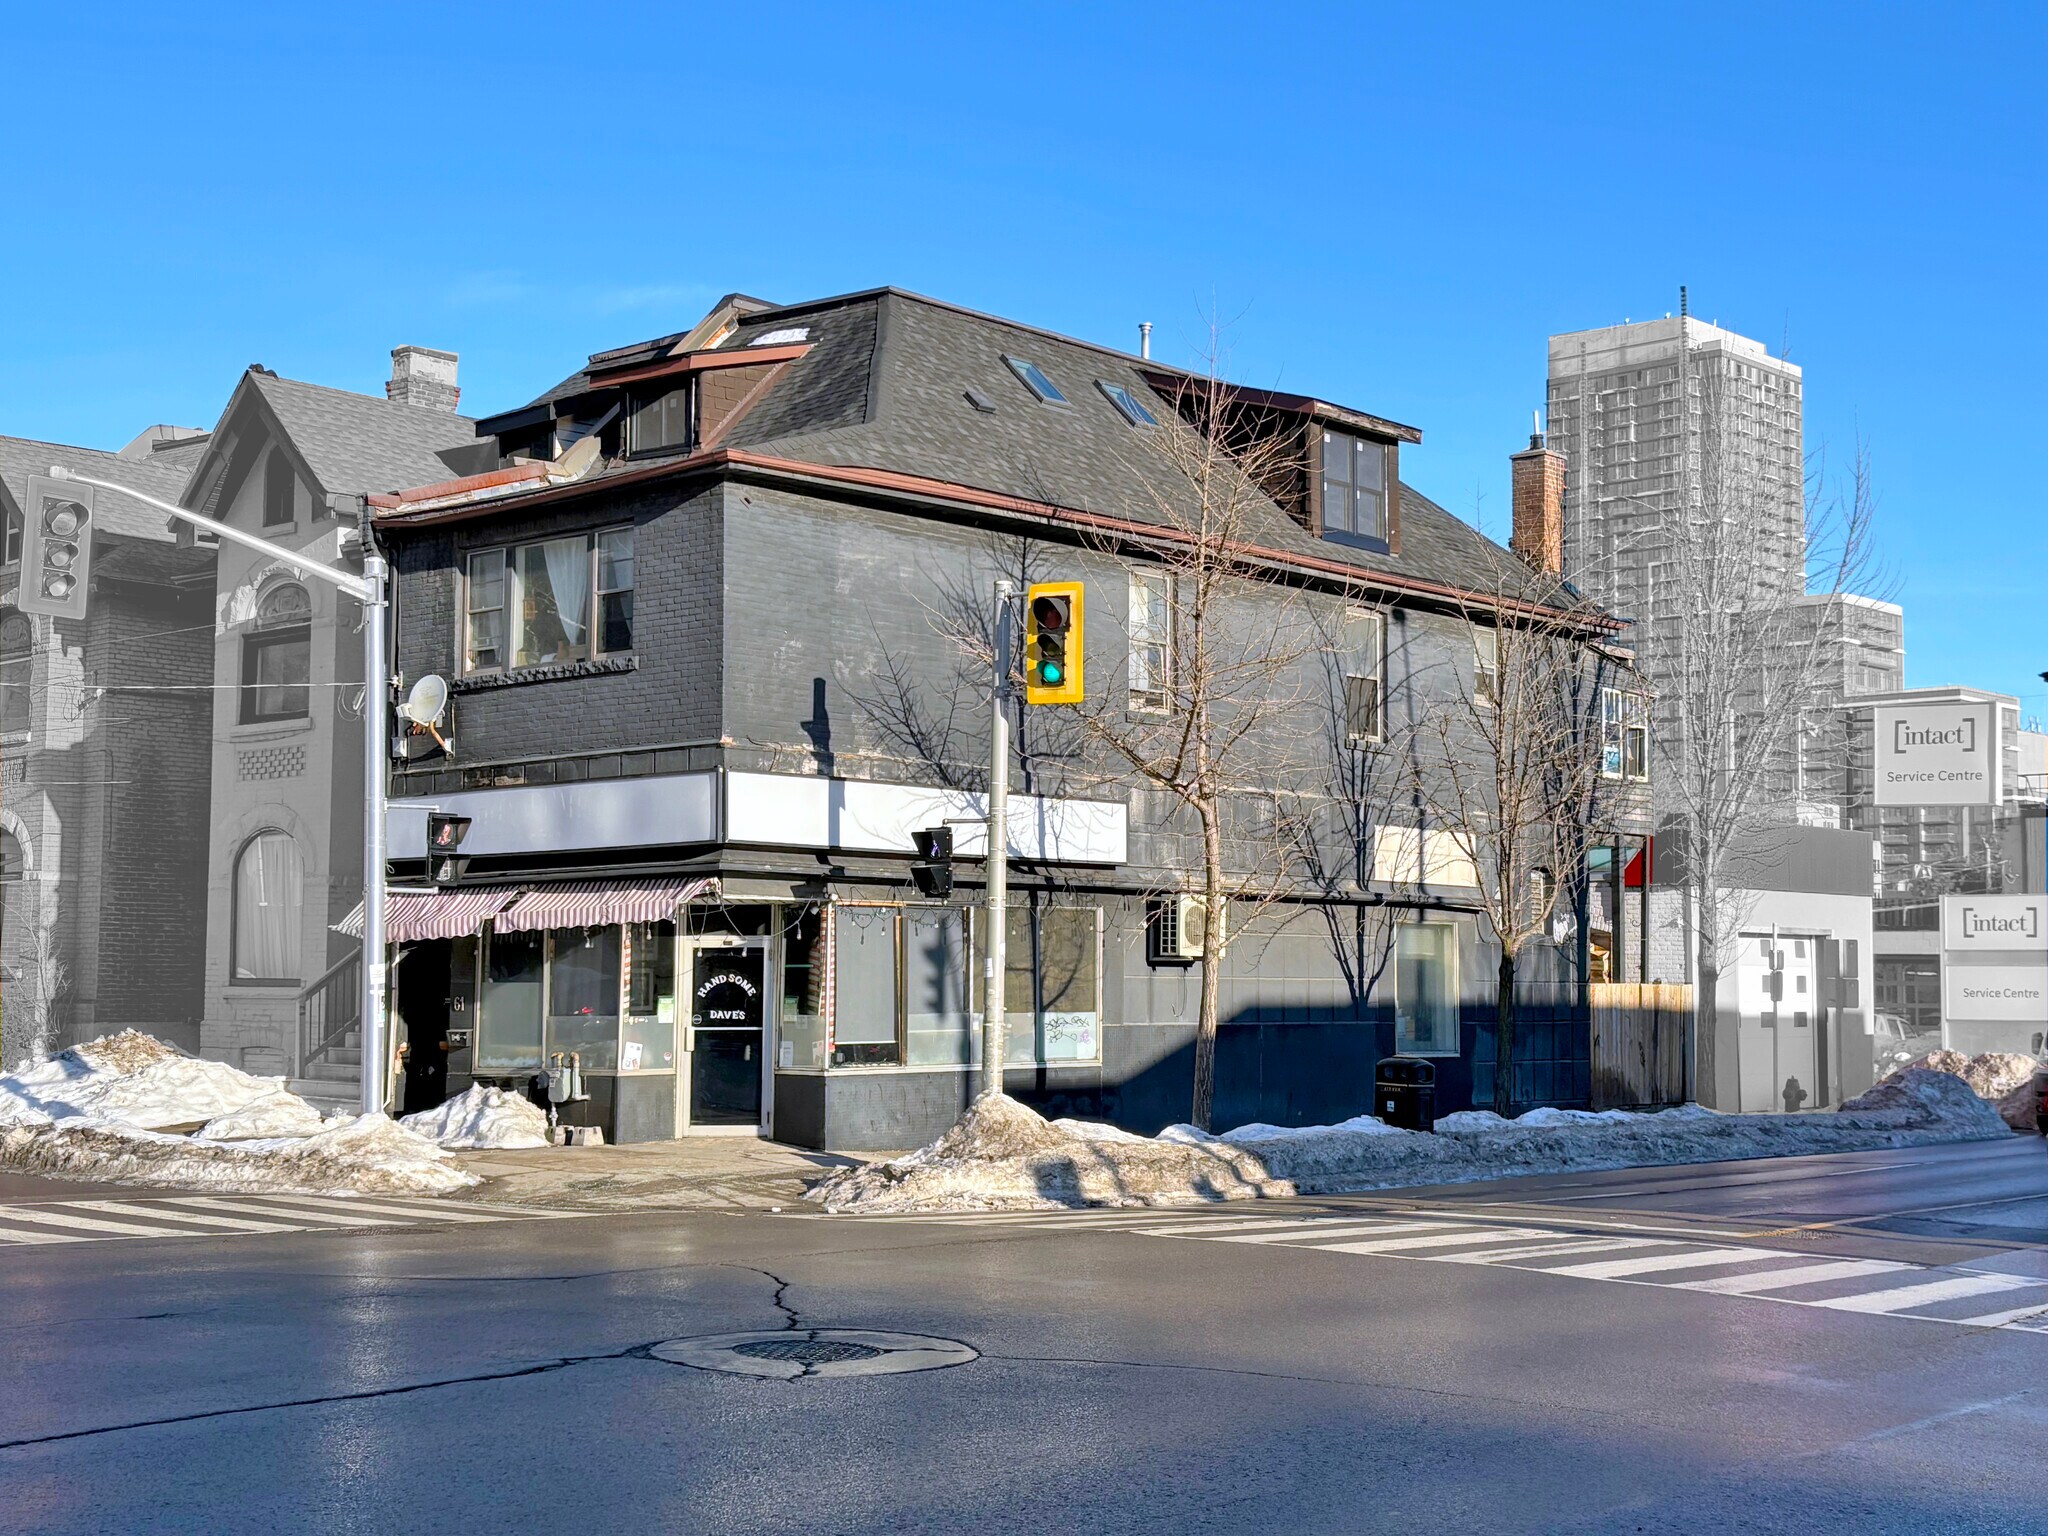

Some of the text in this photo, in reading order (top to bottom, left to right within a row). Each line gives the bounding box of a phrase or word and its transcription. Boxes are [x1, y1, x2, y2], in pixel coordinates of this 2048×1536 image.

[1887, 770, 1983, 783] Service Centre
[1963, 987, 2040, 999] Service Centre
[454, 997, 465, 1012] 61
[709, 1009, 746, 1020] DAVE'S
